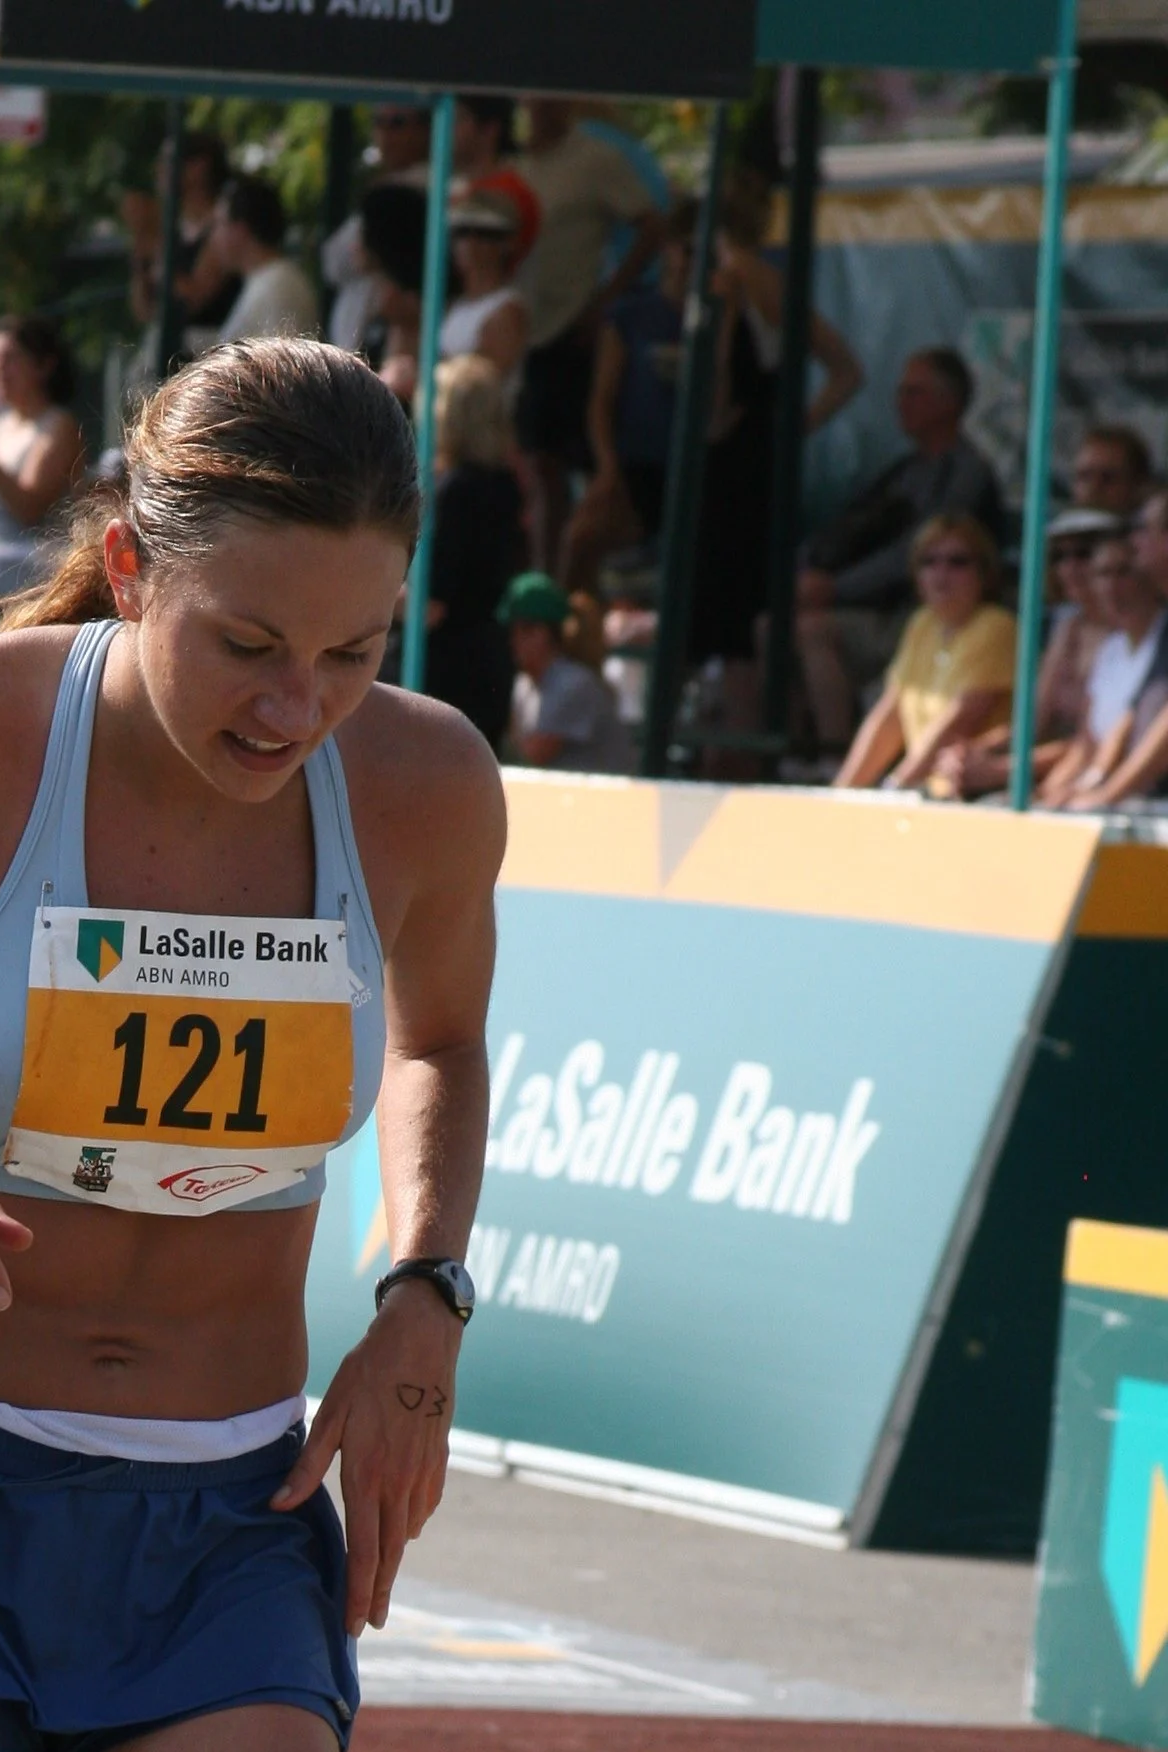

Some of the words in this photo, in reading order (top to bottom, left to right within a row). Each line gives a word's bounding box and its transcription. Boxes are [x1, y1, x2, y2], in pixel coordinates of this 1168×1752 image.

[136, 967, 174, 984] ABN
[180, 969, 230, 988] AMRO
[138, 925, 245, 961] LaSalle
[256, 932, 328, 963] Bank
[103, 1011, 268, 1133] 121
[483, 1032, 698, 1197] LaSalle
[689, 1060, 882, 1226] Bank
[498, 1230, 621, 1326] AMRO
